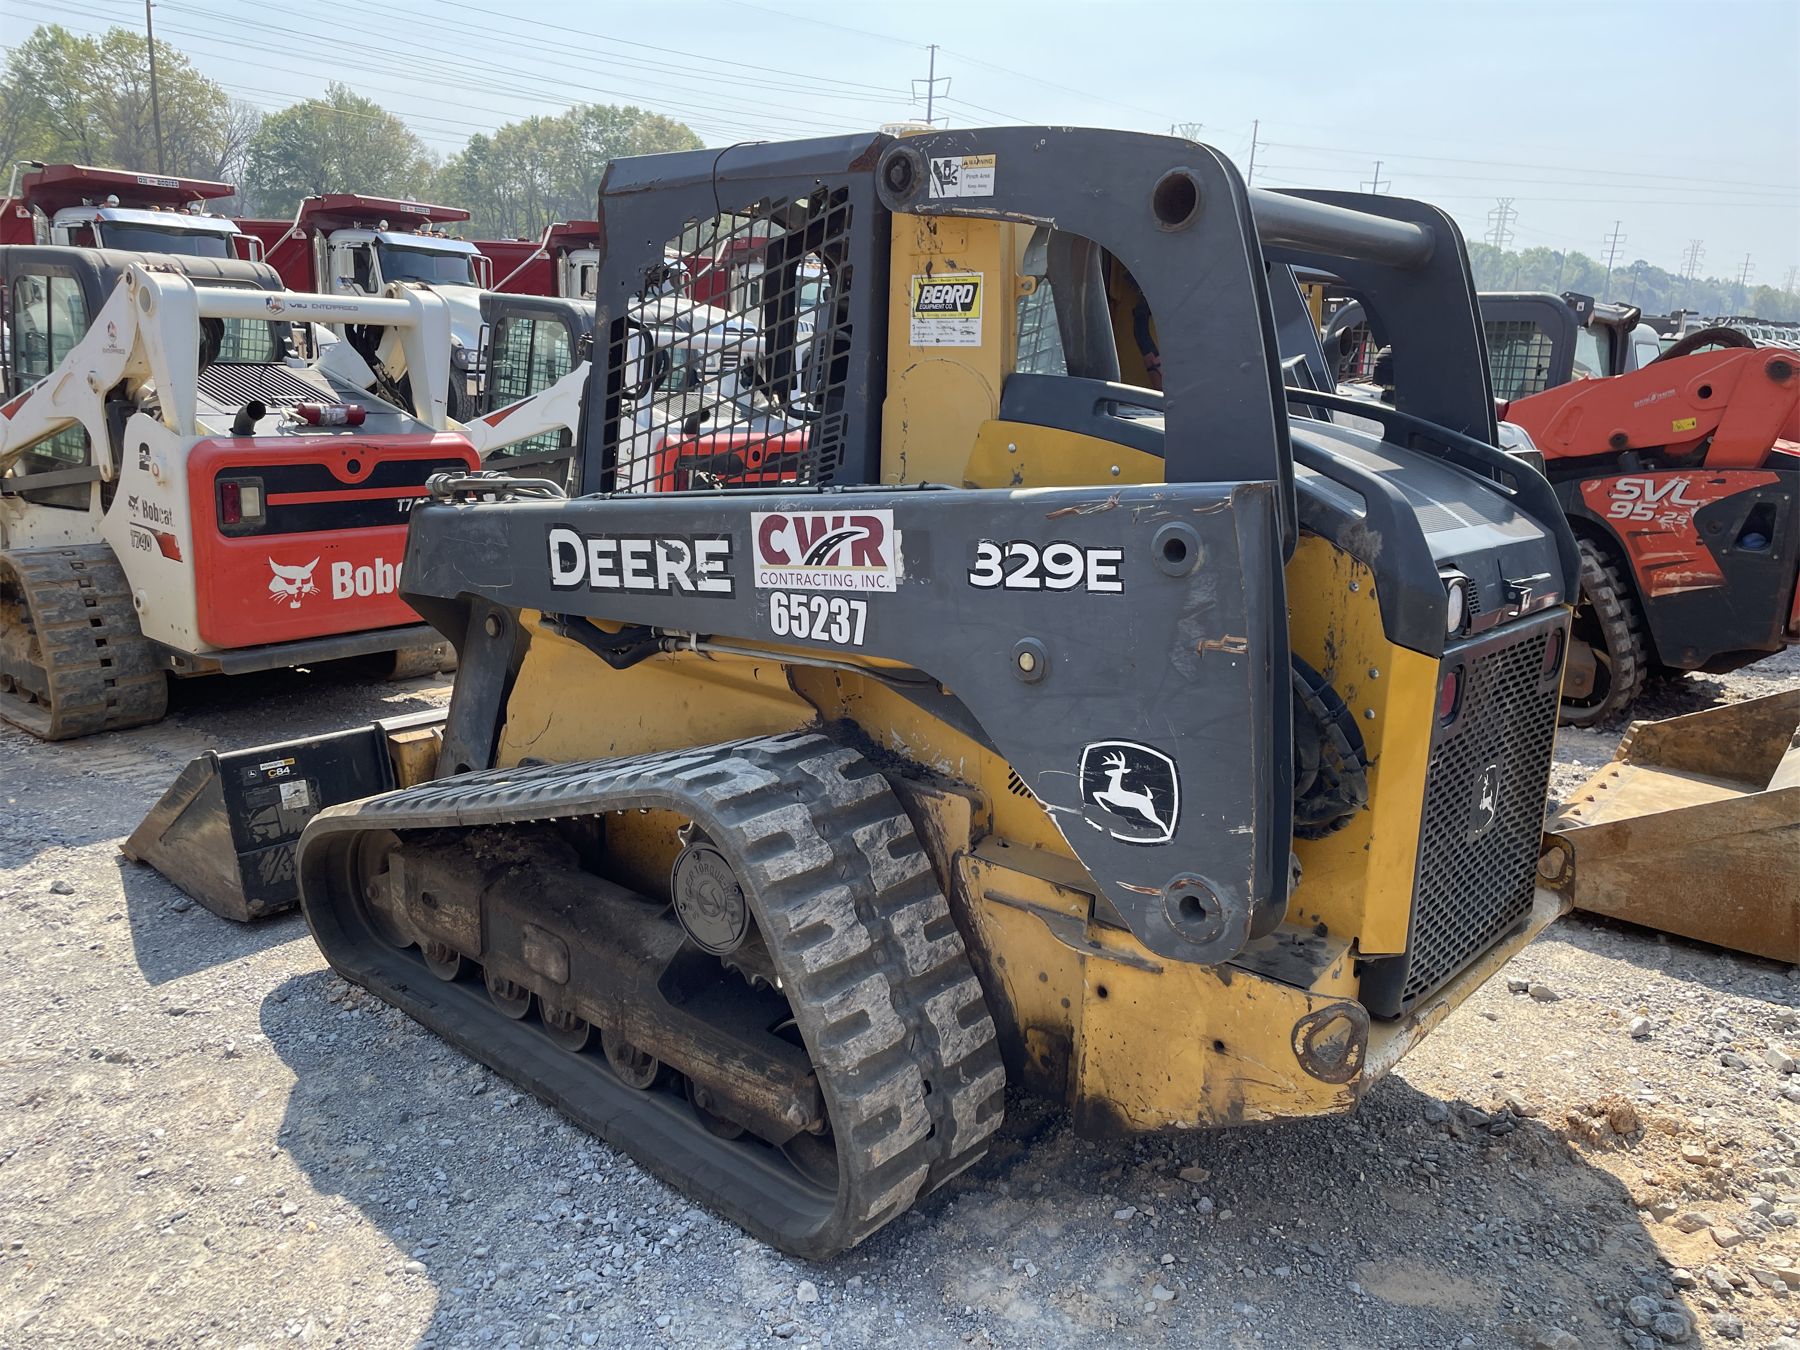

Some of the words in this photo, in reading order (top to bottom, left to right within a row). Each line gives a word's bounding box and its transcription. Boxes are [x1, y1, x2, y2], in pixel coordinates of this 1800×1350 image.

[920, 285, 974, 312] BEARD
[1610, 477, 1700, 506] SVL
[129, 529, 152, 553] T740
[758, 515, 884, 566] CWR
[549, 528, 732, 592] DEERE
[969, 542, 1123, 592] 329E
[760, 572, 857, 590] CONTRACTING,
[860, 573, 890, 589] INC.
[769, 590, 868, 646] 65237
[268, 766, 290, 777] C84
